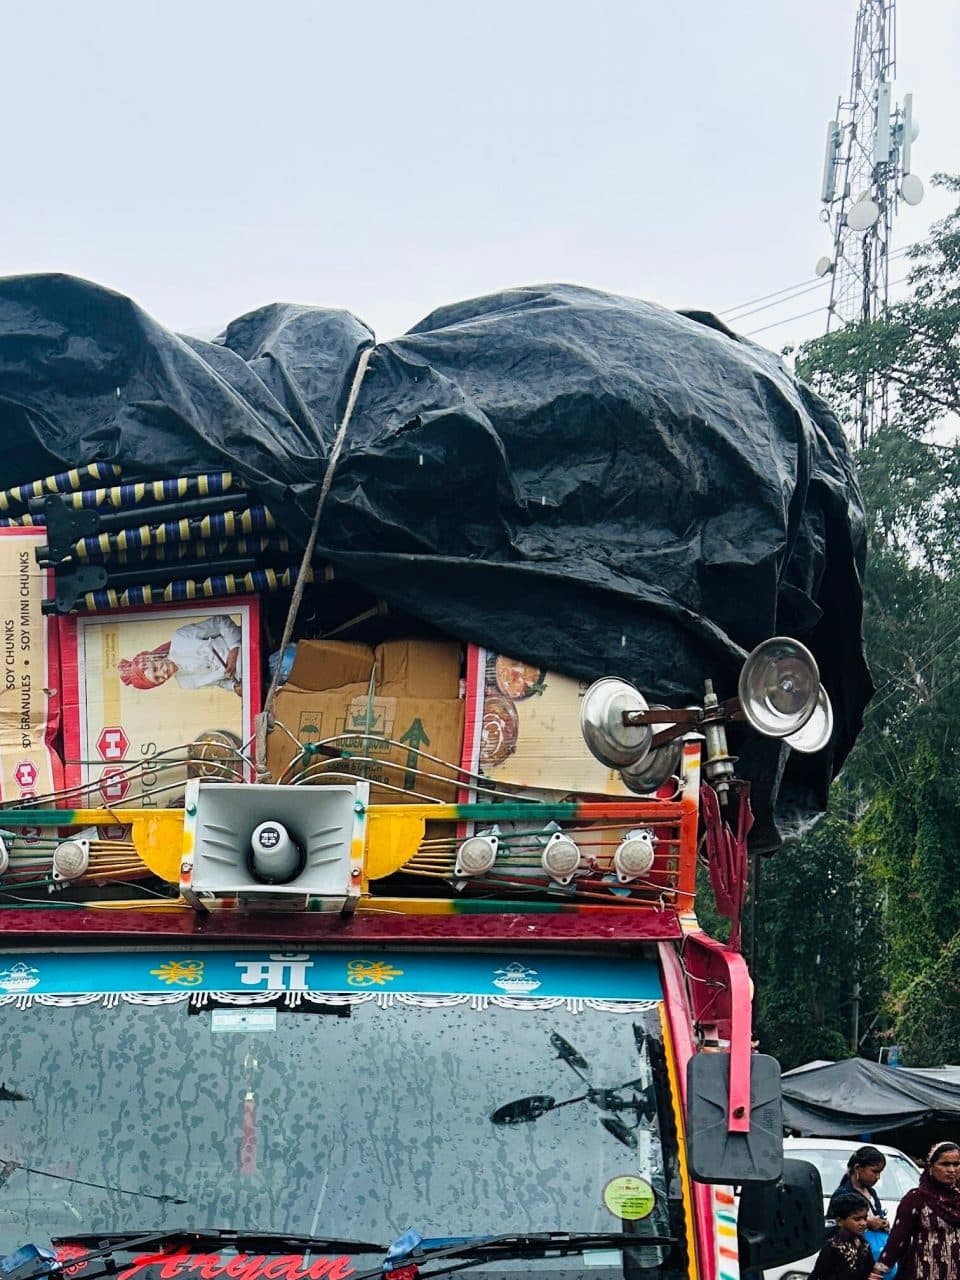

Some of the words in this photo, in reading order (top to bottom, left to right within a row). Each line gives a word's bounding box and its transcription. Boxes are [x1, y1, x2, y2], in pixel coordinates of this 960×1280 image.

[19, 551, 30, 597] CHUNKS
[19, 599, 31, 626] MINI
[3, 619, 16, 665] CHUNKS
[19, 628, 31, 651] SOY
[4, 667, 16, 690] SOY
[20, 674, 32, 730] GRANULES
[140, 741, 158, 808] PICES
